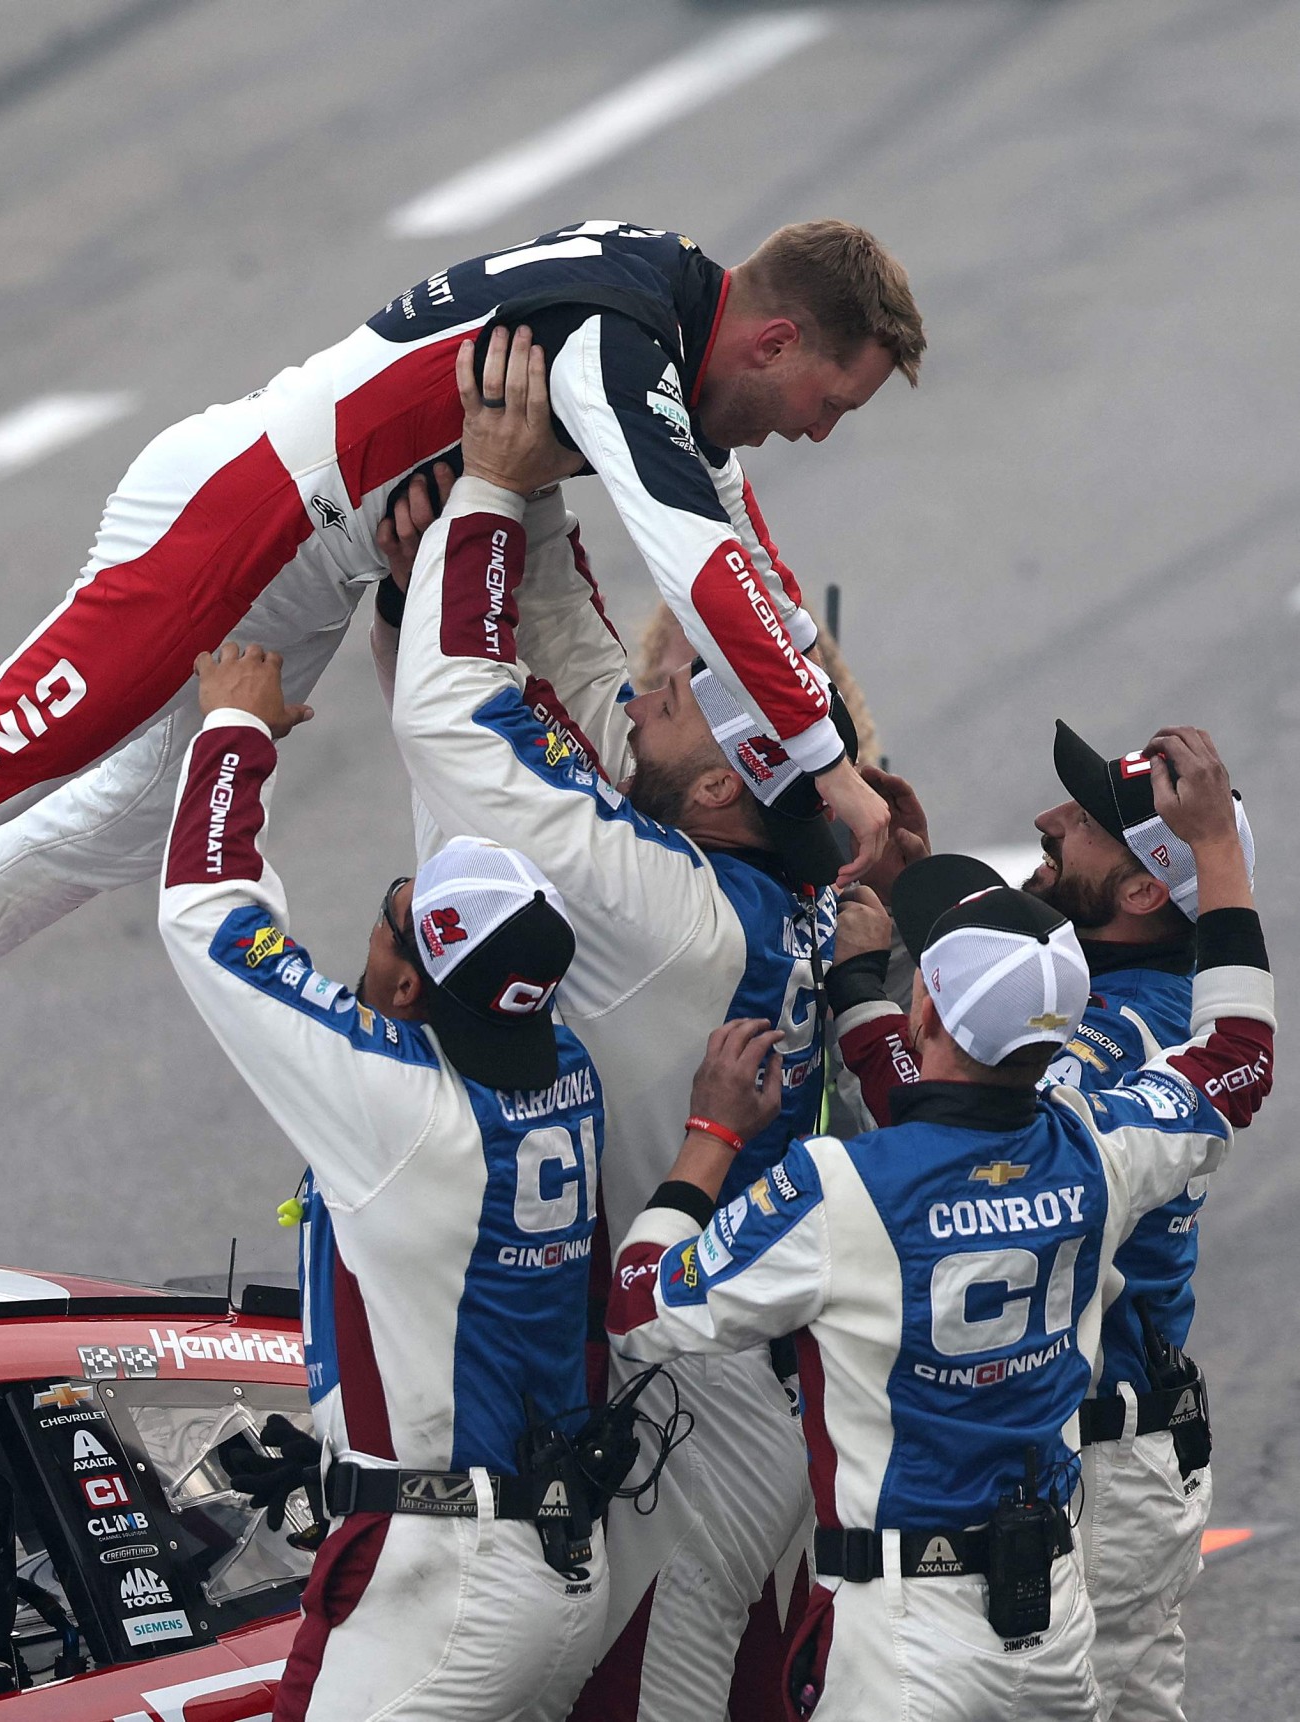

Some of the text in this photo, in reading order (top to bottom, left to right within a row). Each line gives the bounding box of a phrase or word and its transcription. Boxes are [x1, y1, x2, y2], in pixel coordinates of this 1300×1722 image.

[484, 529, 508, 654] CINCINNATI
[725, 551, 824, 708] CINCINNATI
[206, 753, 240, 874] CINCINNATI
[431, 907, 468, 945] 24
[499, 982, 557, 1013] CI
[514, 1115, 597, 1233] CI
[928, 1186, 1085, 1238] CONROY
[930, 1235, 1086, 1356] CI
[149, 1329, 304, 1370] Hendrick
[914, 1334, 1070, 1388] CINCINNATI
[39, 1410, 106, 1429] CHEVROLET
[73, 1456, 117, 1472] AXALTA
[85, 1477, 128, 1506] CI
[400, 1497, 461, 1513] MECHANIX
[87, 1512, 149, 1536] CLIMB
[98, 1530, 148, 1542] CHANNEL SOLUTIONS
[106, 1547, 153, 1561] FREIGHTLINER
[916, 1563, 963, 1573] AXALTA
[120, 1567, 169, 1599] MAC
[123, 1592, 173, 1609] TOOLS
[134, 1619, 183, 1636] SIEMENS
[1003, 1635, 1043, 1652] SIMPSON
